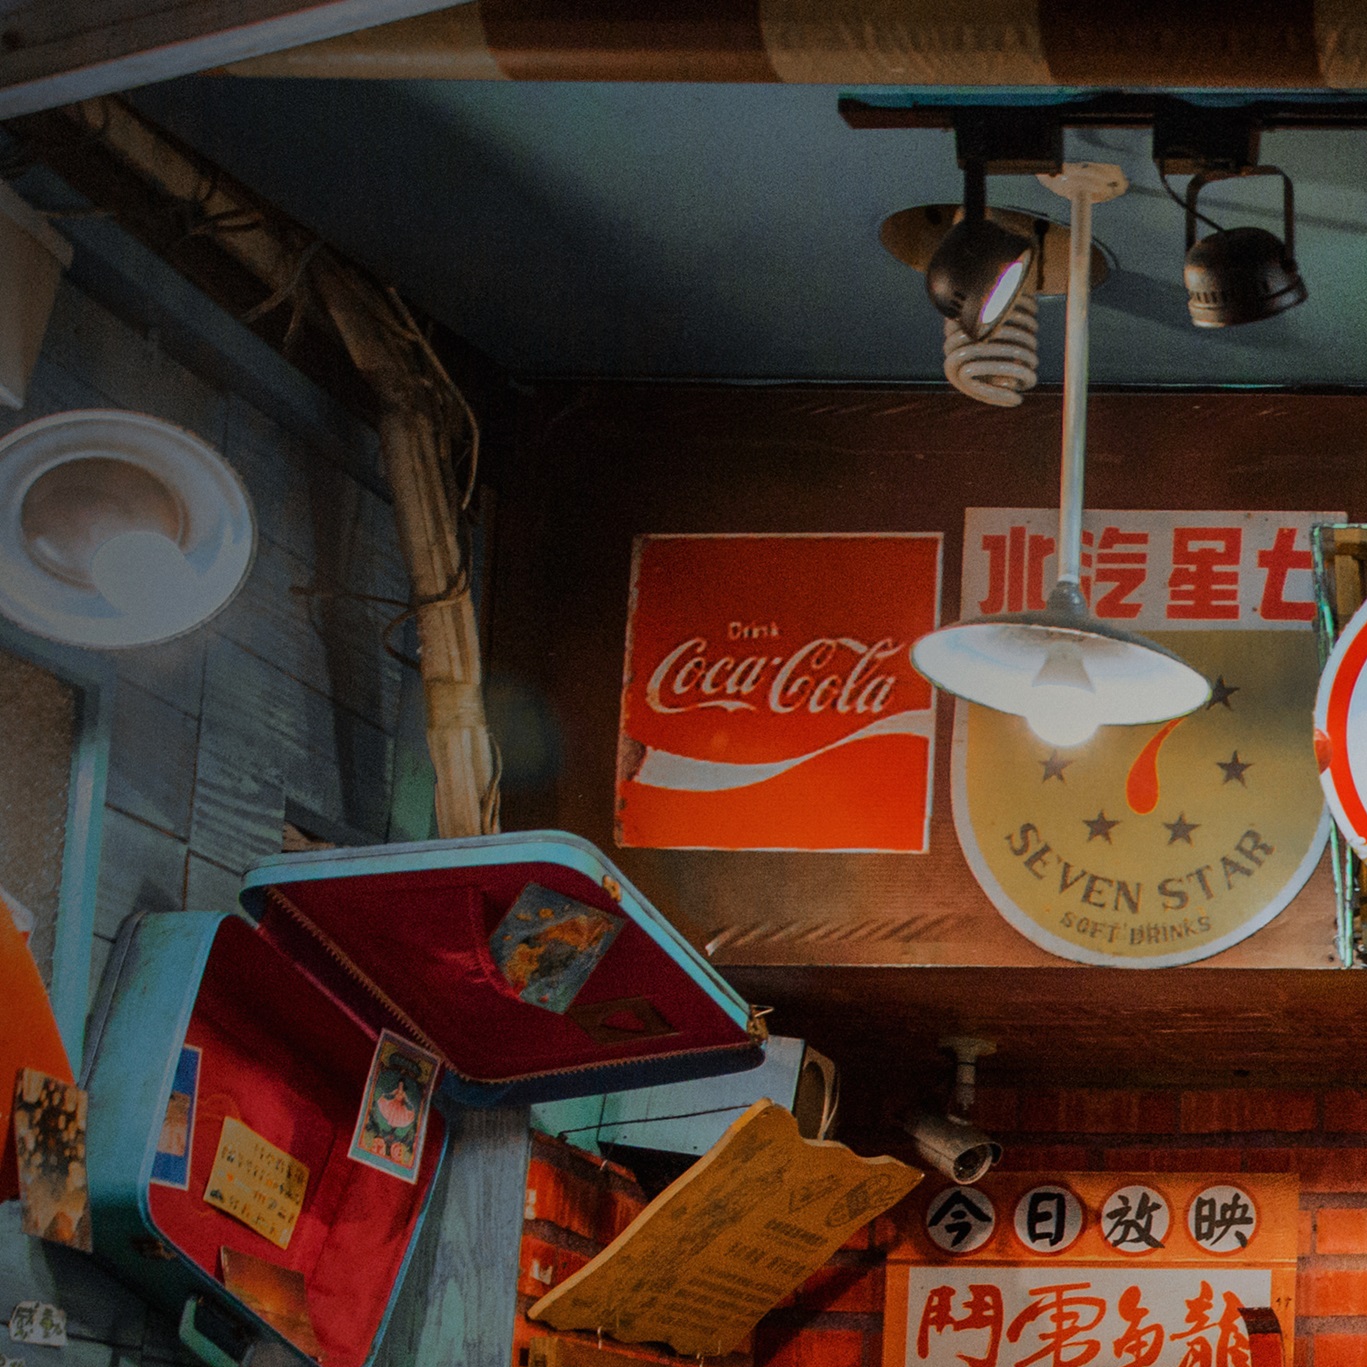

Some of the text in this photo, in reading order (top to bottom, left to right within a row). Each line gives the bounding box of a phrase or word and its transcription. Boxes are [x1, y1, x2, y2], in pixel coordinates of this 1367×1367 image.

[728, 620, 780, 641] Drink
[1004, 819, 1277, 916] SEVEN STAR
[1059, 910, 1213, 946] SOFT DRINKS
[927, 1195, 1256, 1249] 今日放映
